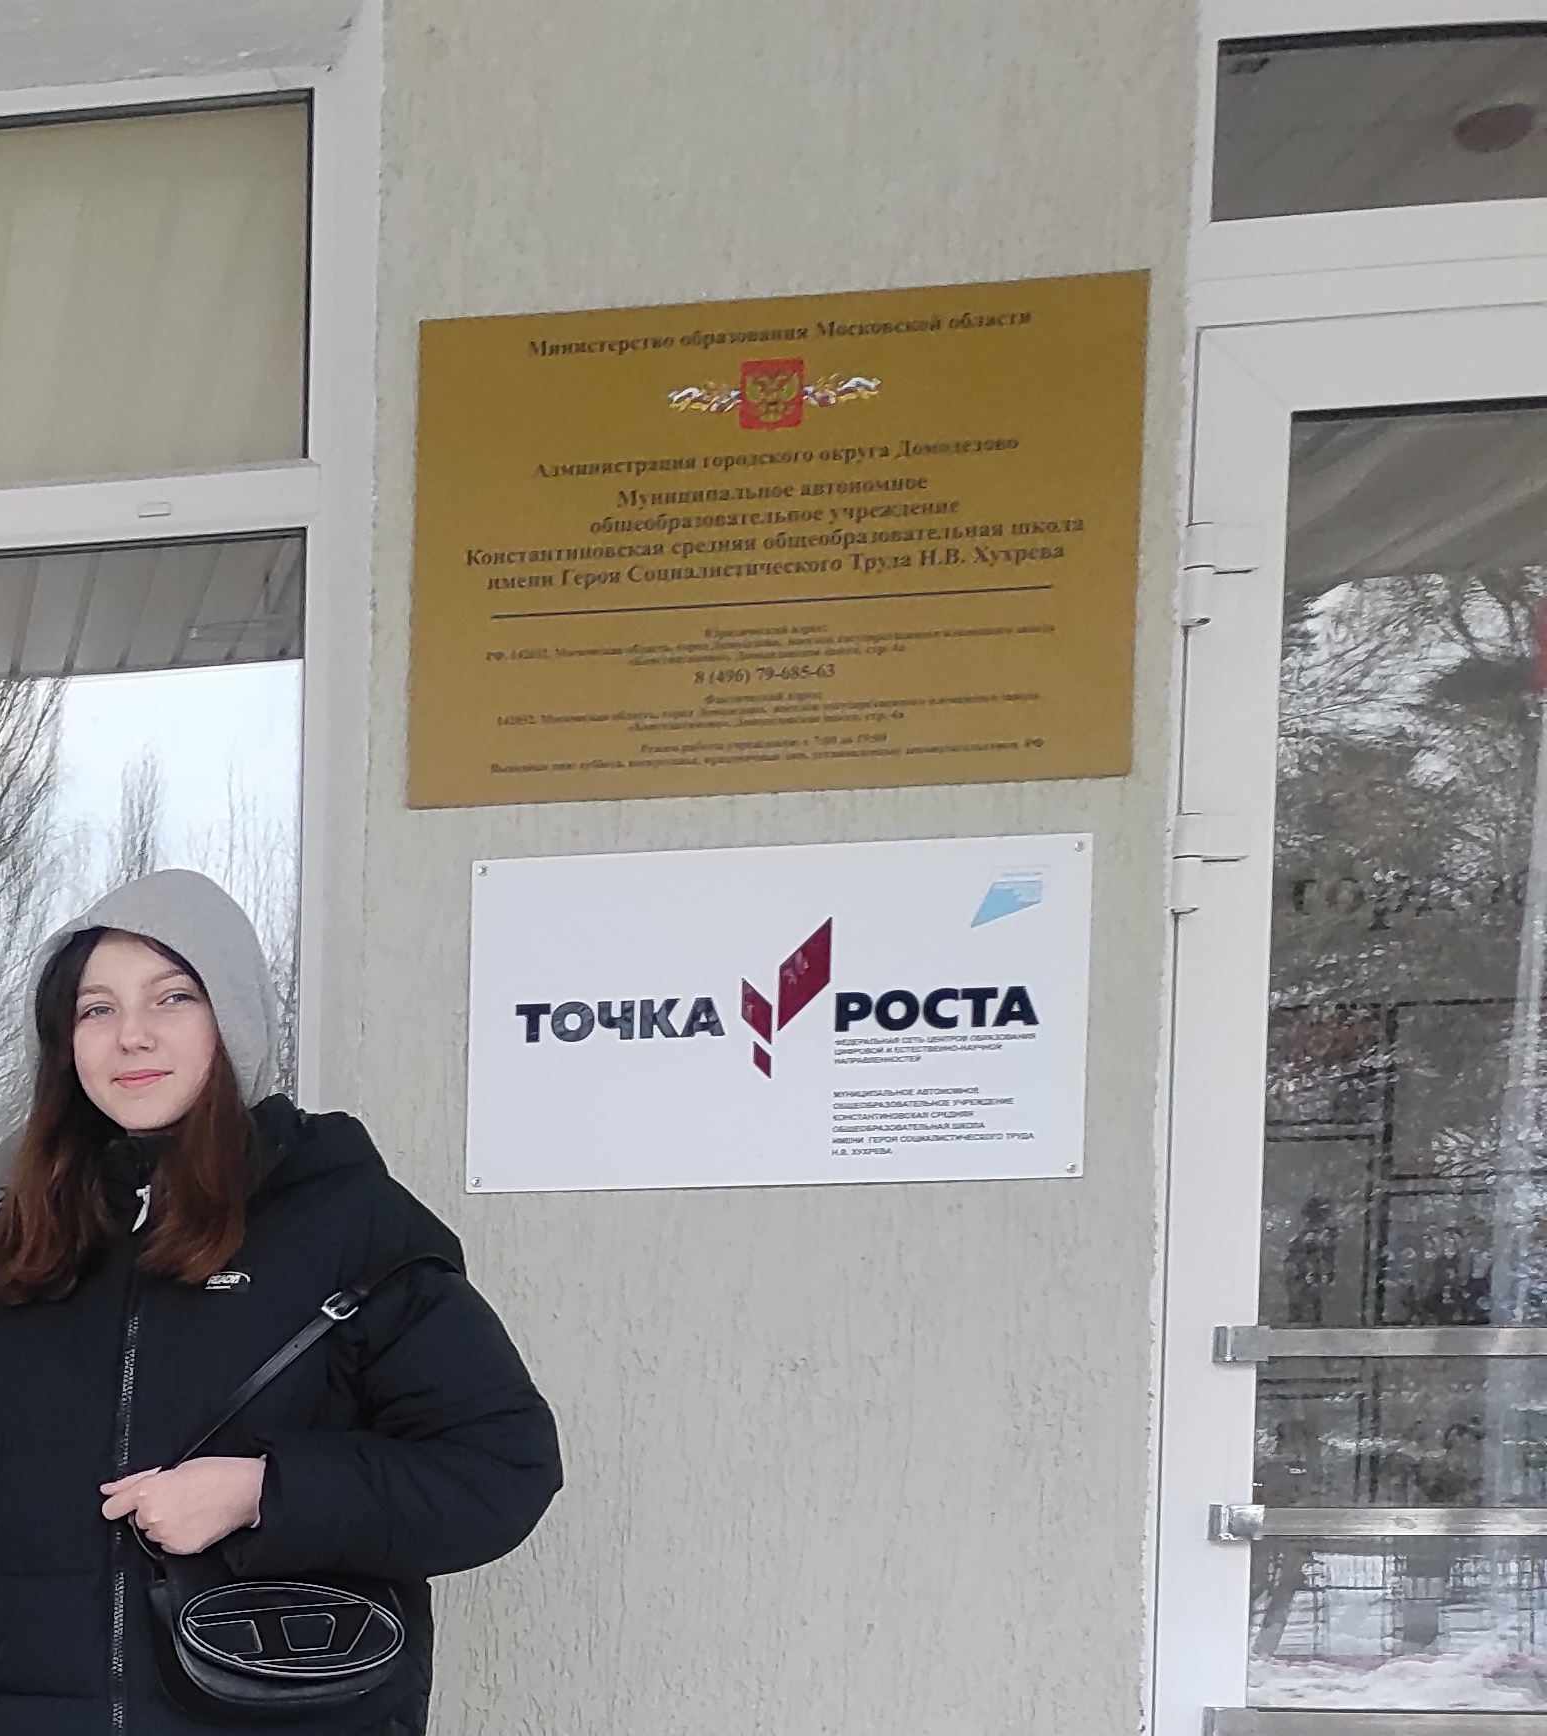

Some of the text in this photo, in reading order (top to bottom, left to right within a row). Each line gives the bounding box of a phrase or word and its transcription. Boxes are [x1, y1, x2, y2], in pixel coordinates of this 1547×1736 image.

[530, 312, 1031, 357] Министерство образования Московской области
[538, 438, 1019, 478] Администрация городского округа Домодедово
[617, 477, 928, 510] Муниципальное автономное
[590, 501, 959, 535] общеобразовательное учреждение
[467, 519, 1084, 566] Константиновская средняя общеобразовательная школа
[488, 546, 1064, 590] имени Героя Социалистического Труда Н.В. Хухрева
[694, 663, 835, 685] 8 (496) 79-685-63
[516, 986, 1040, 1044] ТОЧКА РОСТА
[970, 1033, 1036, 1042] ОБРАЗОВАНИЯ
[833, 1100, 950, 1109] ОБЩЕОБРАЗОВАТЕЛЬНОЕ
[833, 1112, 929, 1121] КОНСТАНТИНОВСКАЯ
[832, 1123, 950, 1132] ОБЩЕОБРАЗОВАТЕЛЬНАЯ
[869, 1136, 898, 1144] ГЕРОЯ
[900, 1133, 1003, 1143] СОЦИАЛИСТИЧЕСКОГО
[832, 1148, 849, 1156] Н.В.
